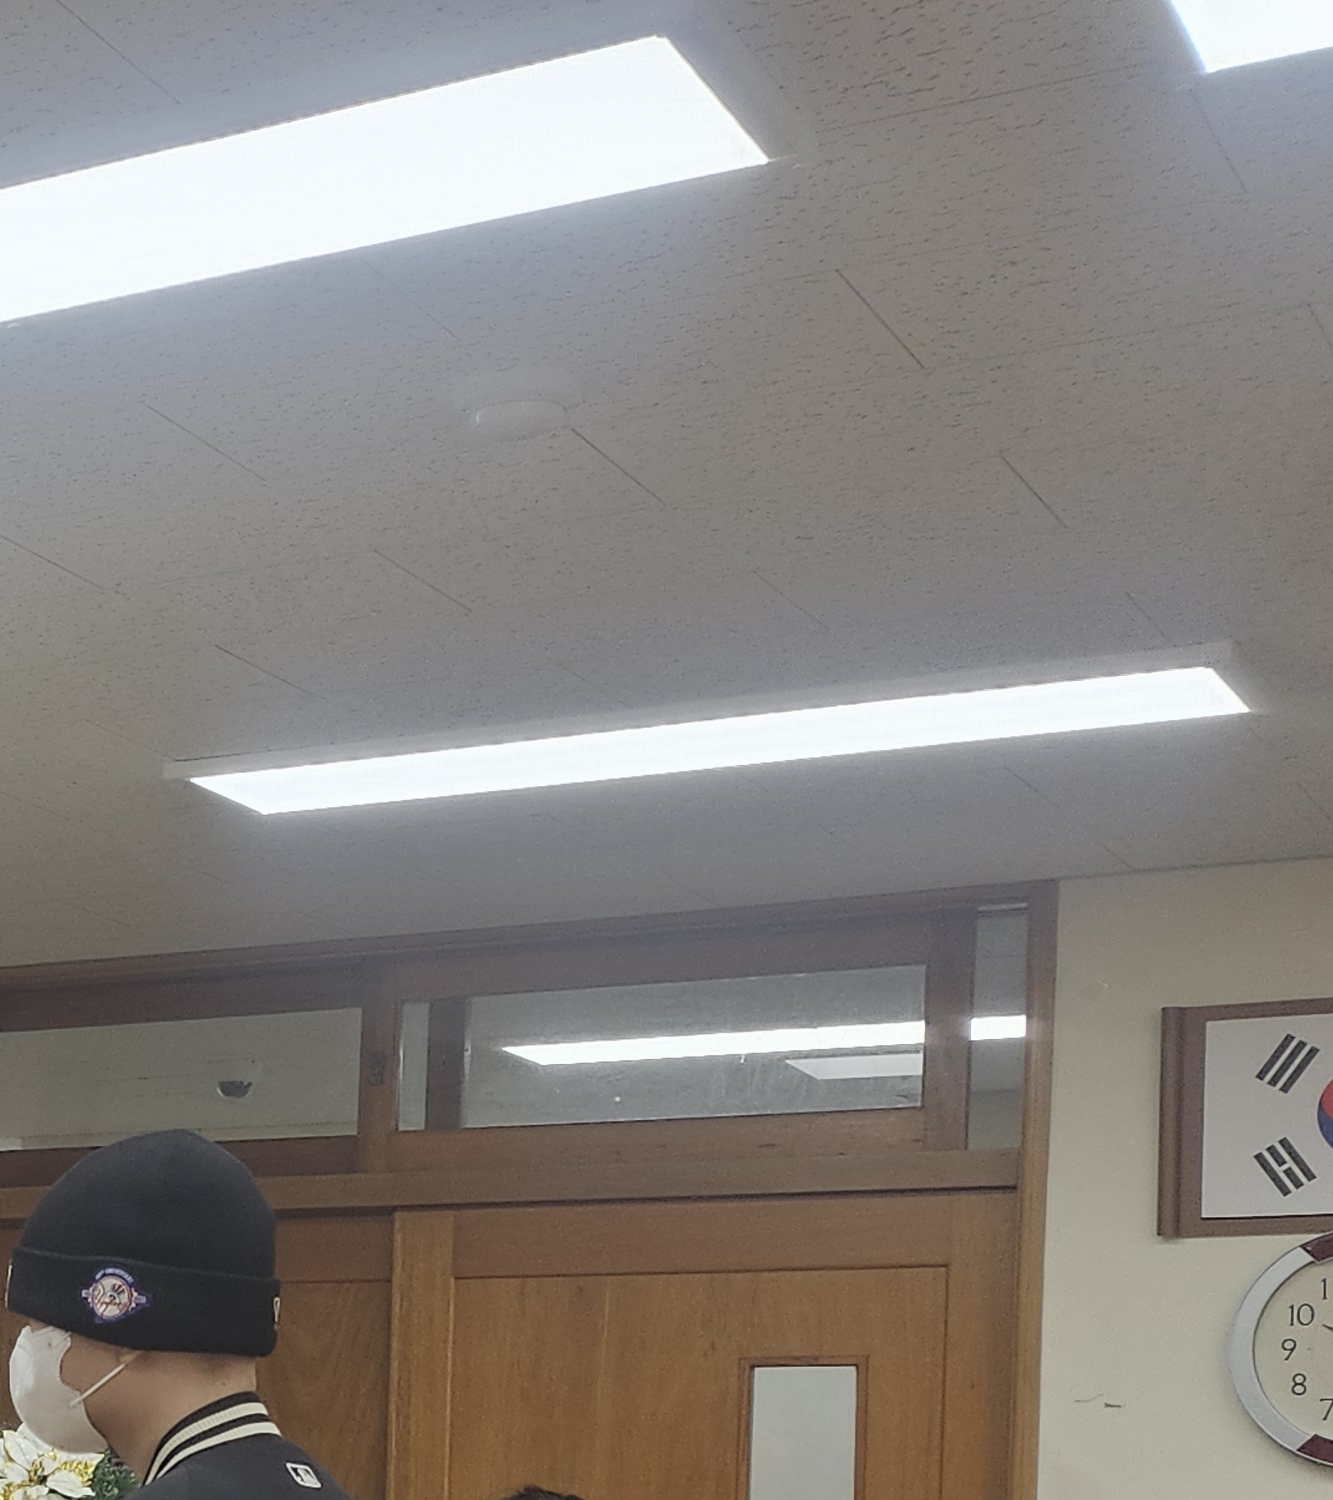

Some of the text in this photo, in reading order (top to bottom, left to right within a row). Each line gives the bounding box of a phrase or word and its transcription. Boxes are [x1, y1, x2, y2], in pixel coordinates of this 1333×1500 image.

[1288, 1303, 1315, 1327] 10
[1281, 1338, 1297, 1361] 9
[1291, 1373, 1307, 1396] 8
[1319, 1398, 1333, 1421] 7
